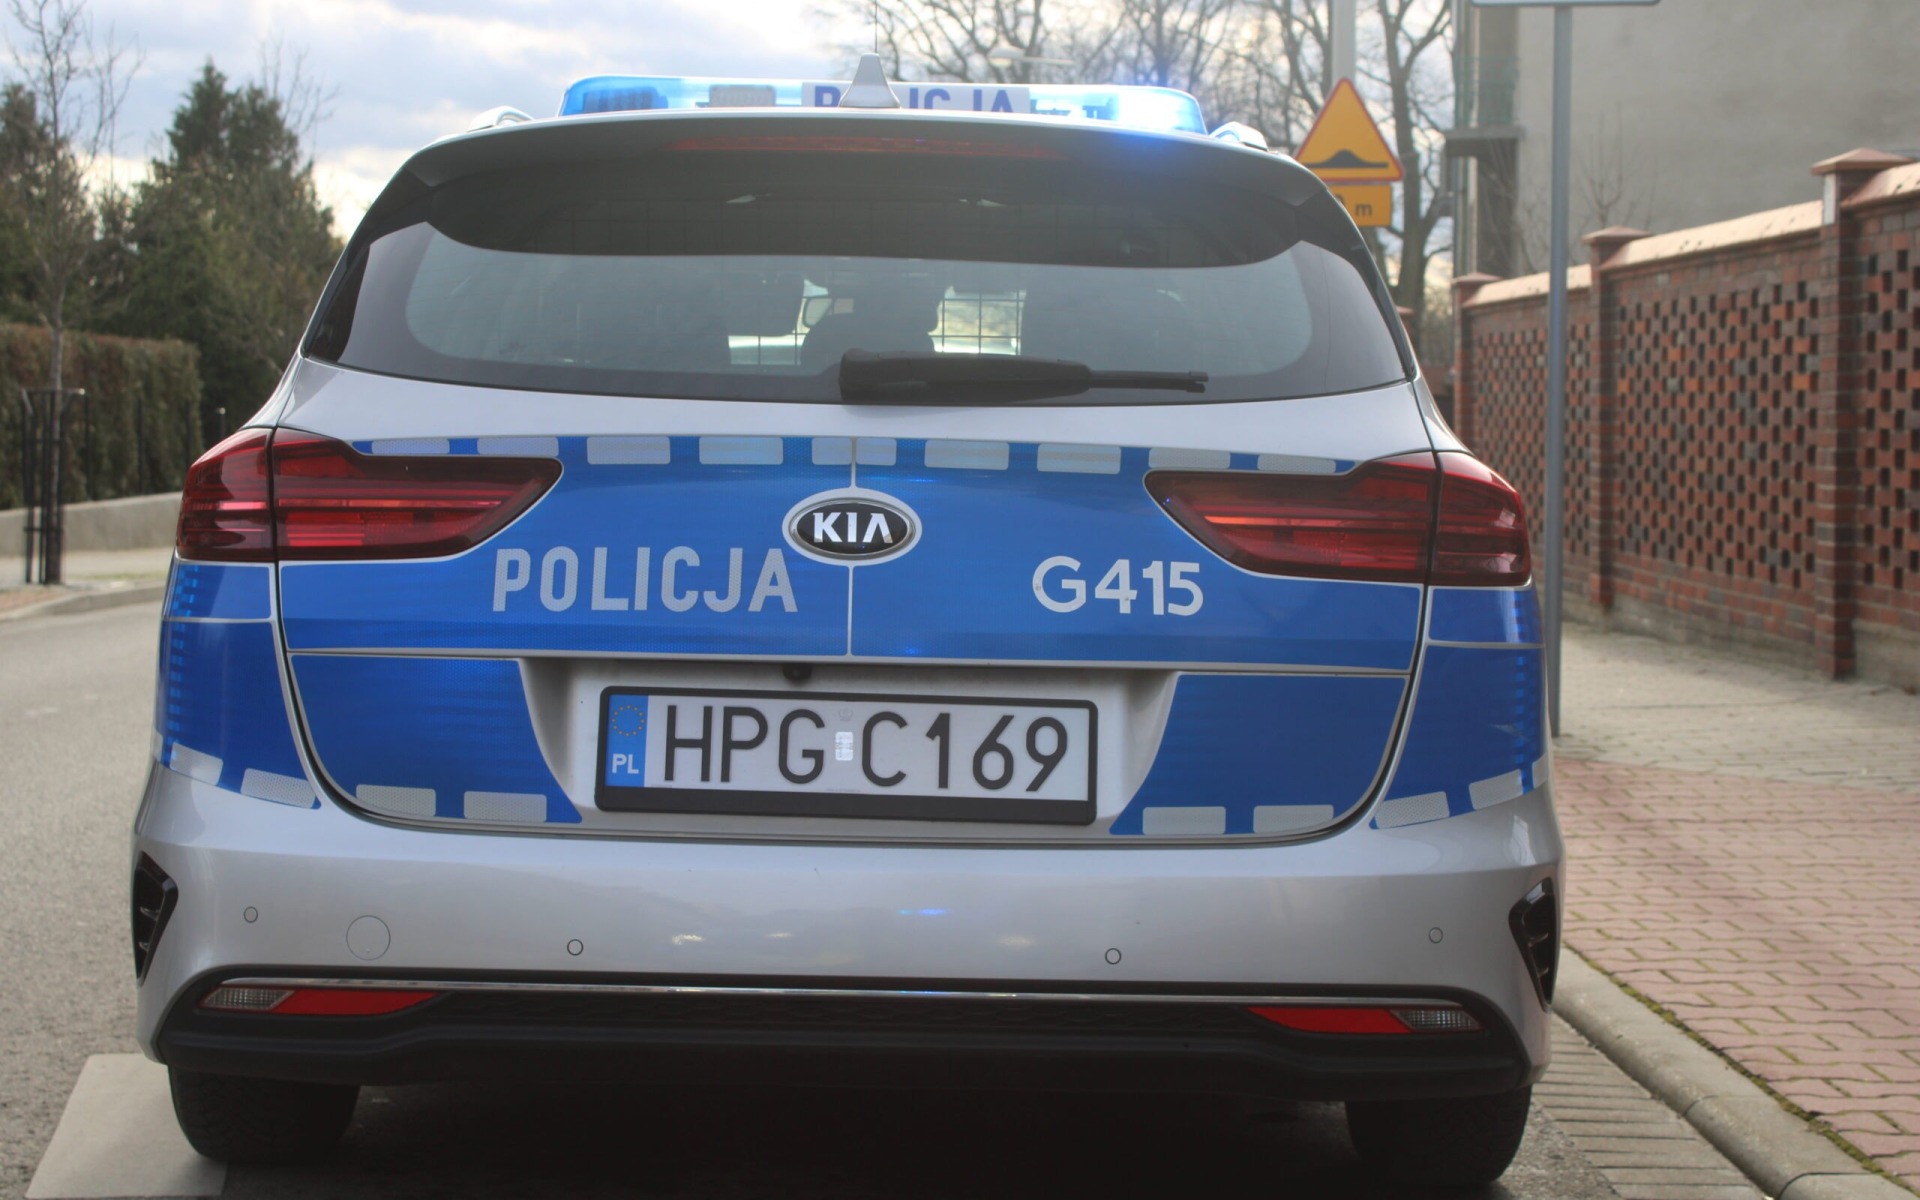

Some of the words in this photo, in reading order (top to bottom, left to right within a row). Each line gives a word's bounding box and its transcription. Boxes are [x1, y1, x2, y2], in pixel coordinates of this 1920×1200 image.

[812, 511, 894, 544] KIA
[492, 545, 798, 612] POLICJA
[1032, 555, 1204, 616] G415
[611, 753, 640, 775] PL
[664, 705, 826, 785] HPG
[861, 711, 1068, 793] C169
